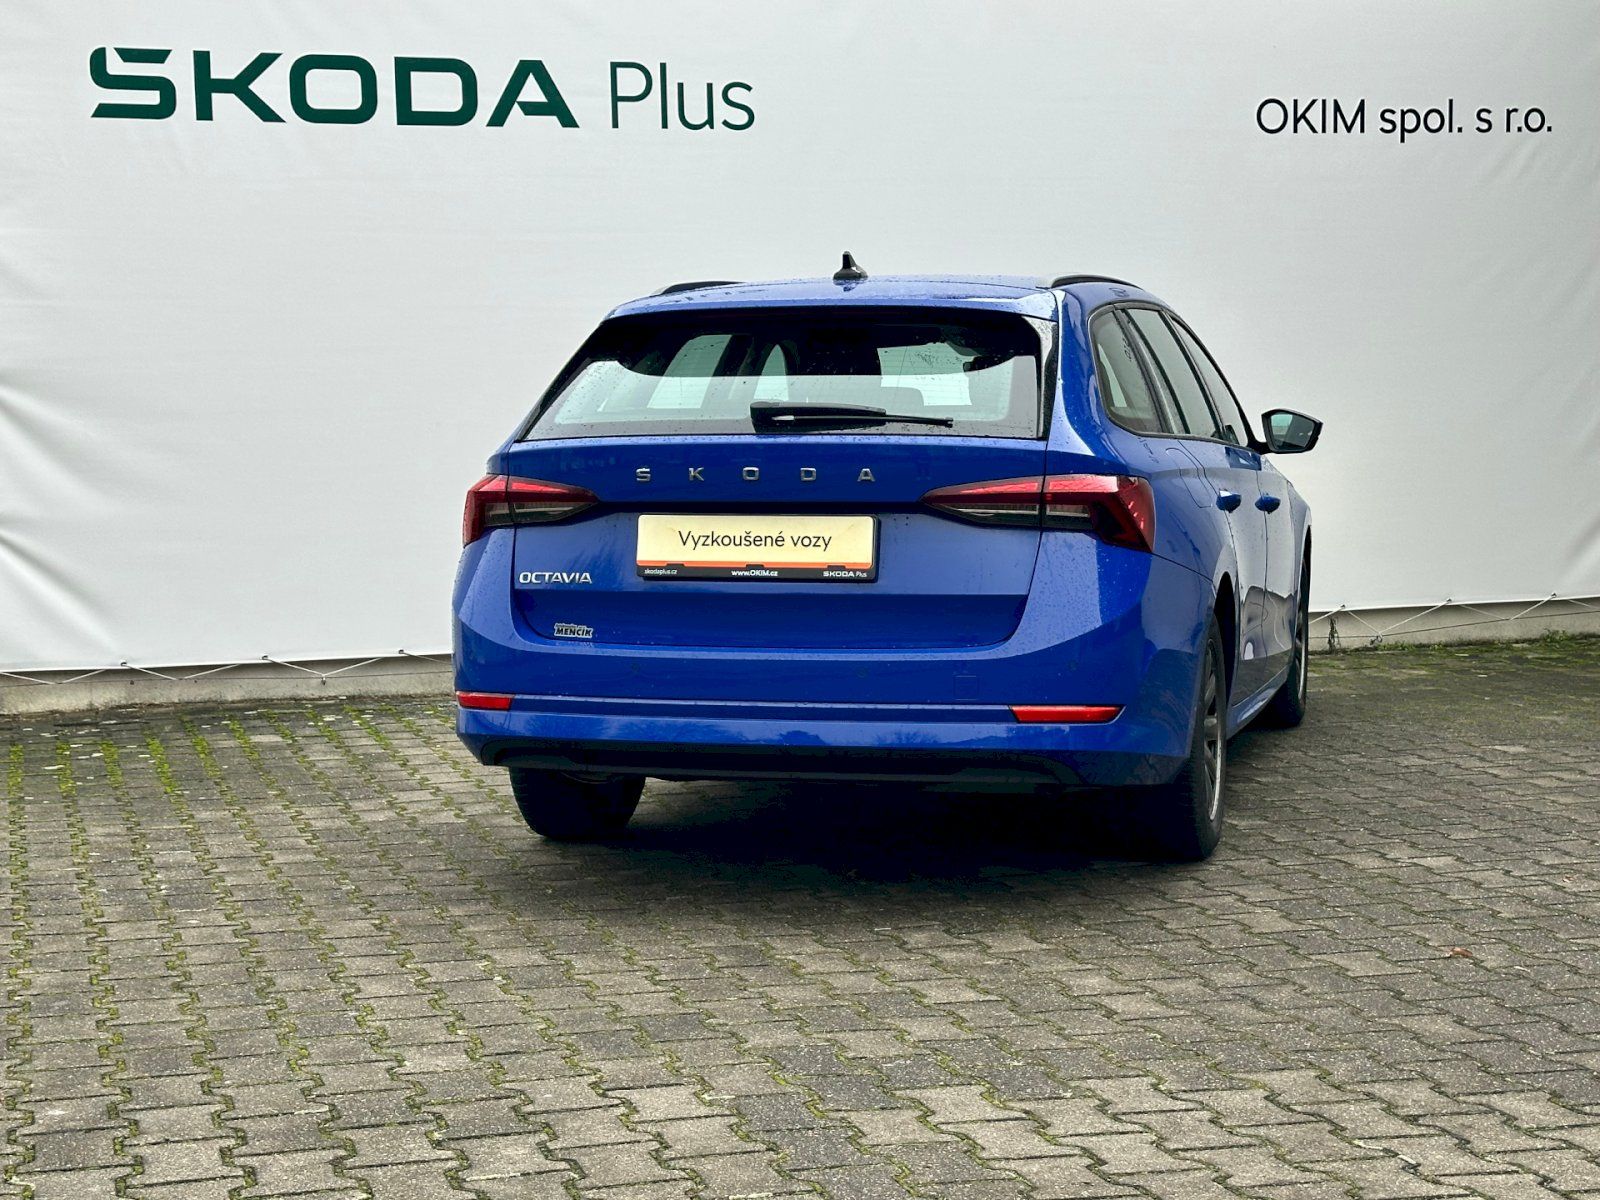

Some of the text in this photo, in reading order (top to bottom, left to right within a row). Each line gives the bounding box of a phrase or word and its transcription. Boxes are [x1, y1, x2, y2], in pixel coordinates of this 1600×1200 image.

[609, 61, 756, 132] Plus
[1256, 98, 1553, 144] OKIM spol. s r.o.
[678, 530, 832, 552] Vyzkoušené vozy
[519, 571, 593, 584] OCTAVIA
[731, 569, 779, 577] www.OKIM.cz
